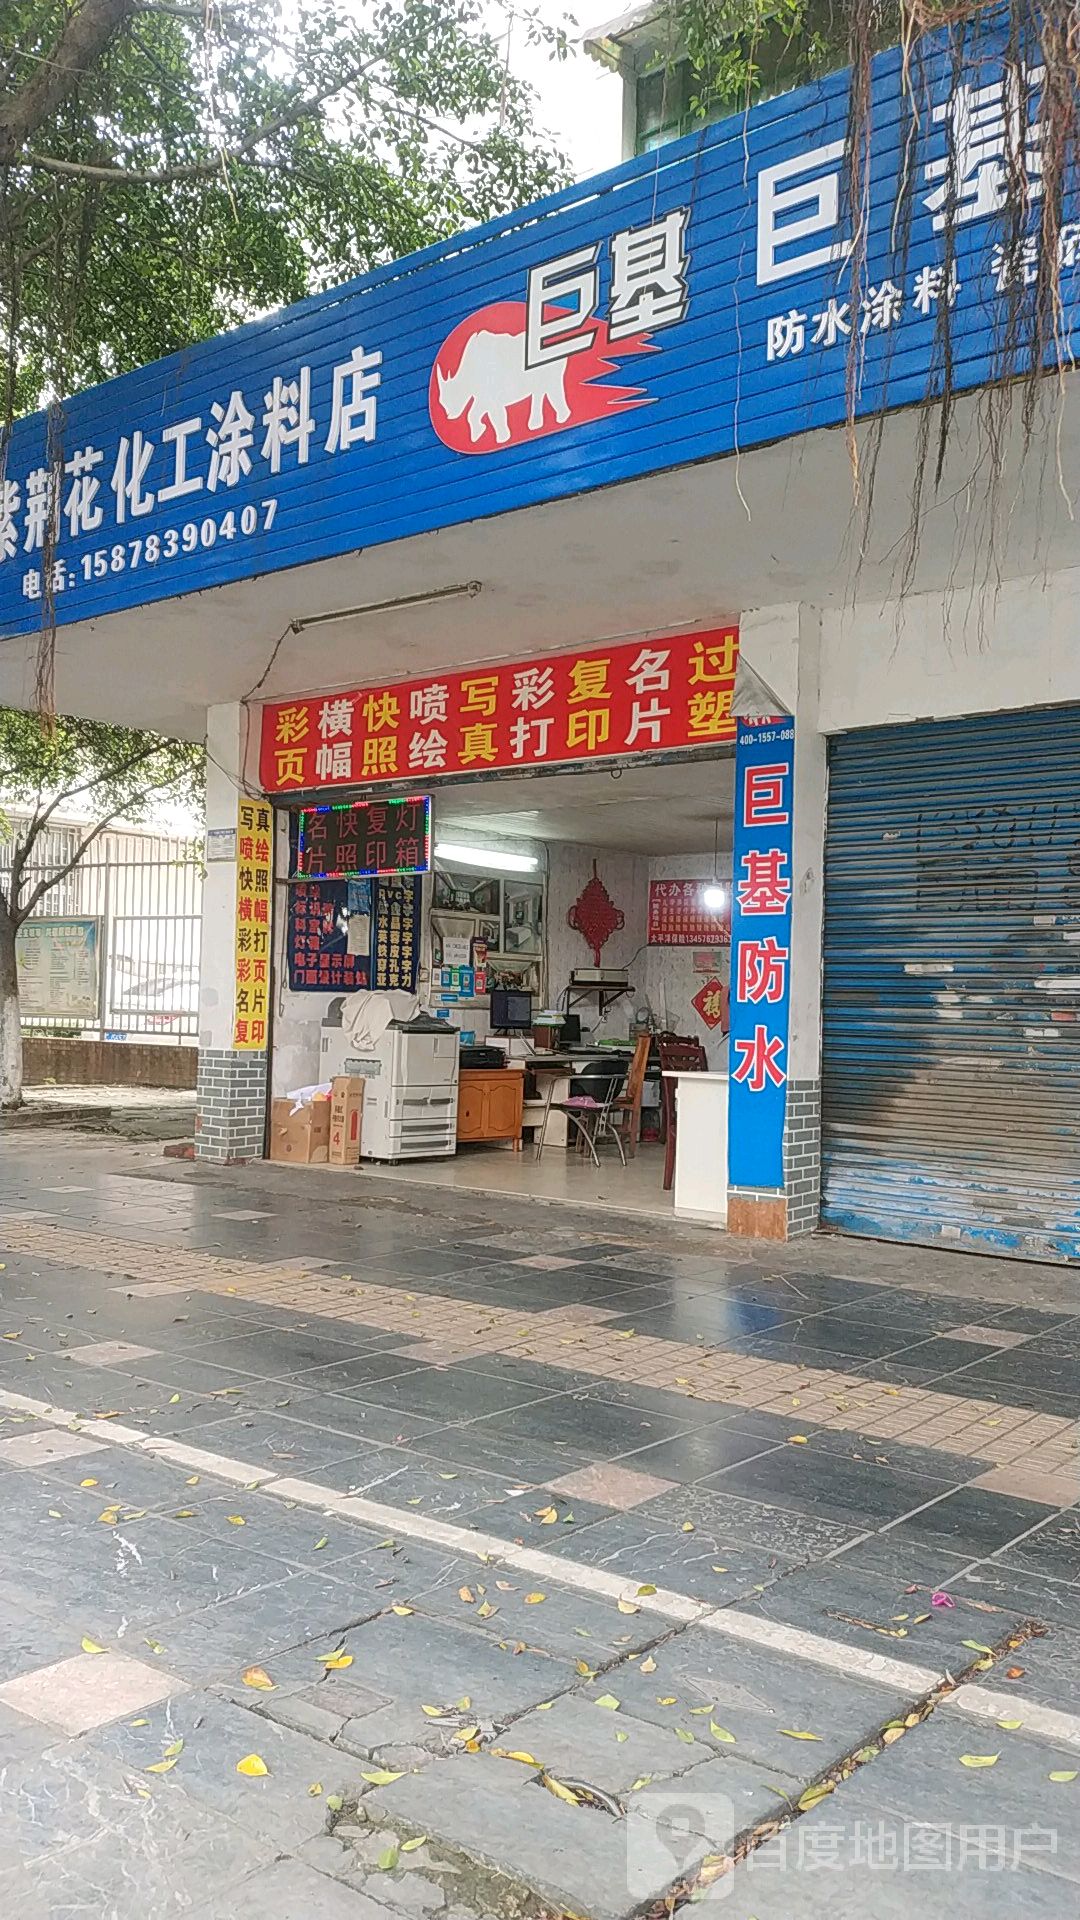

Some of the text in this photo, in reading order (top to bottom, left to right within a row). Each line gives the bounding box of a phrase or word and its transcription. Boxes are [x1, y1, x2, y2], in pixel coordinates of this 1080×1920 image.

[526, 207, 691, 369] 巨基
[766, 260, 961, 361] 防水涂料
[241, 806, 270, 833] 写真
[240, 836, 269, 863] 喷绘
[239, 866, 269, 893] 快照
[238, 898, 268, 924] 横幅
[237, 927, 267, 954] 彩打
[731, 762, 791, 1092] 巨基防水
[236, 957, 266, 983] 彩页
[236, 988, 266, 1014] 名片
[235, 1018, 265, 1044] 复印
